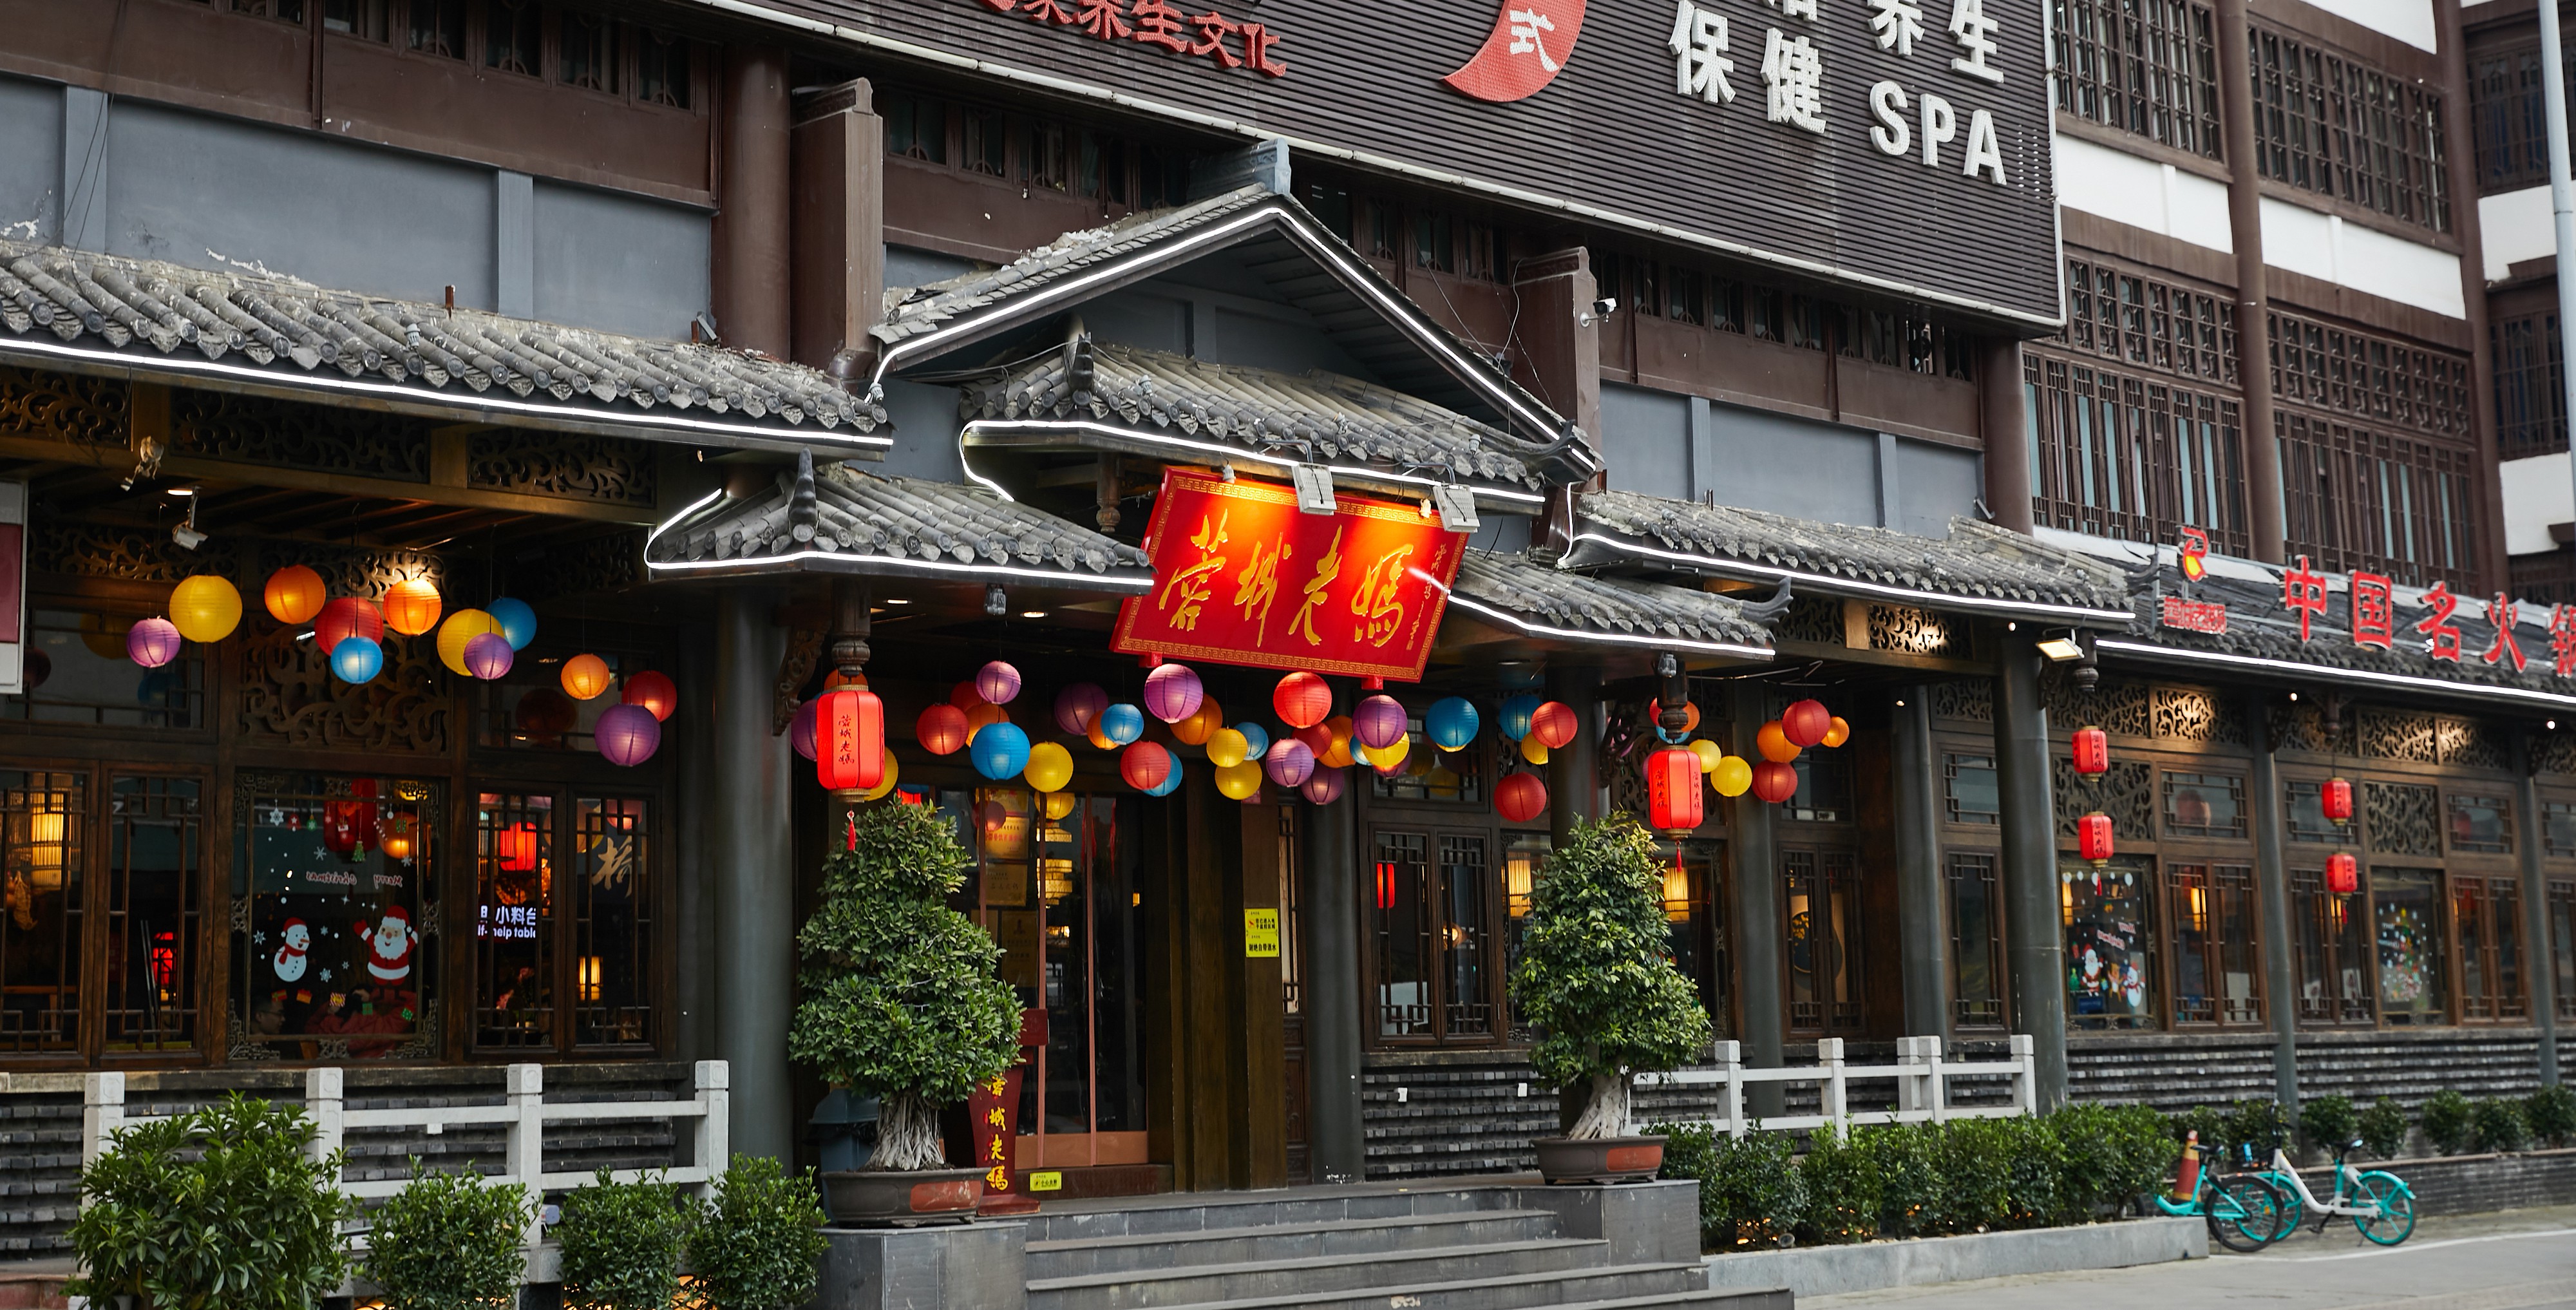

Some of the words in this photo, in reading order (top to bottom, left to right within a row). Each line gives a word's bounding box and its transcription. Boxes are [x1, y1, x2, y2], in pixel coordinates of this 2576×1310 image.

[1509, 8, 1560, 72] 式
[1668, 0, 1827, 134] 保健
[1869, 80, 2007, 186] SPA
